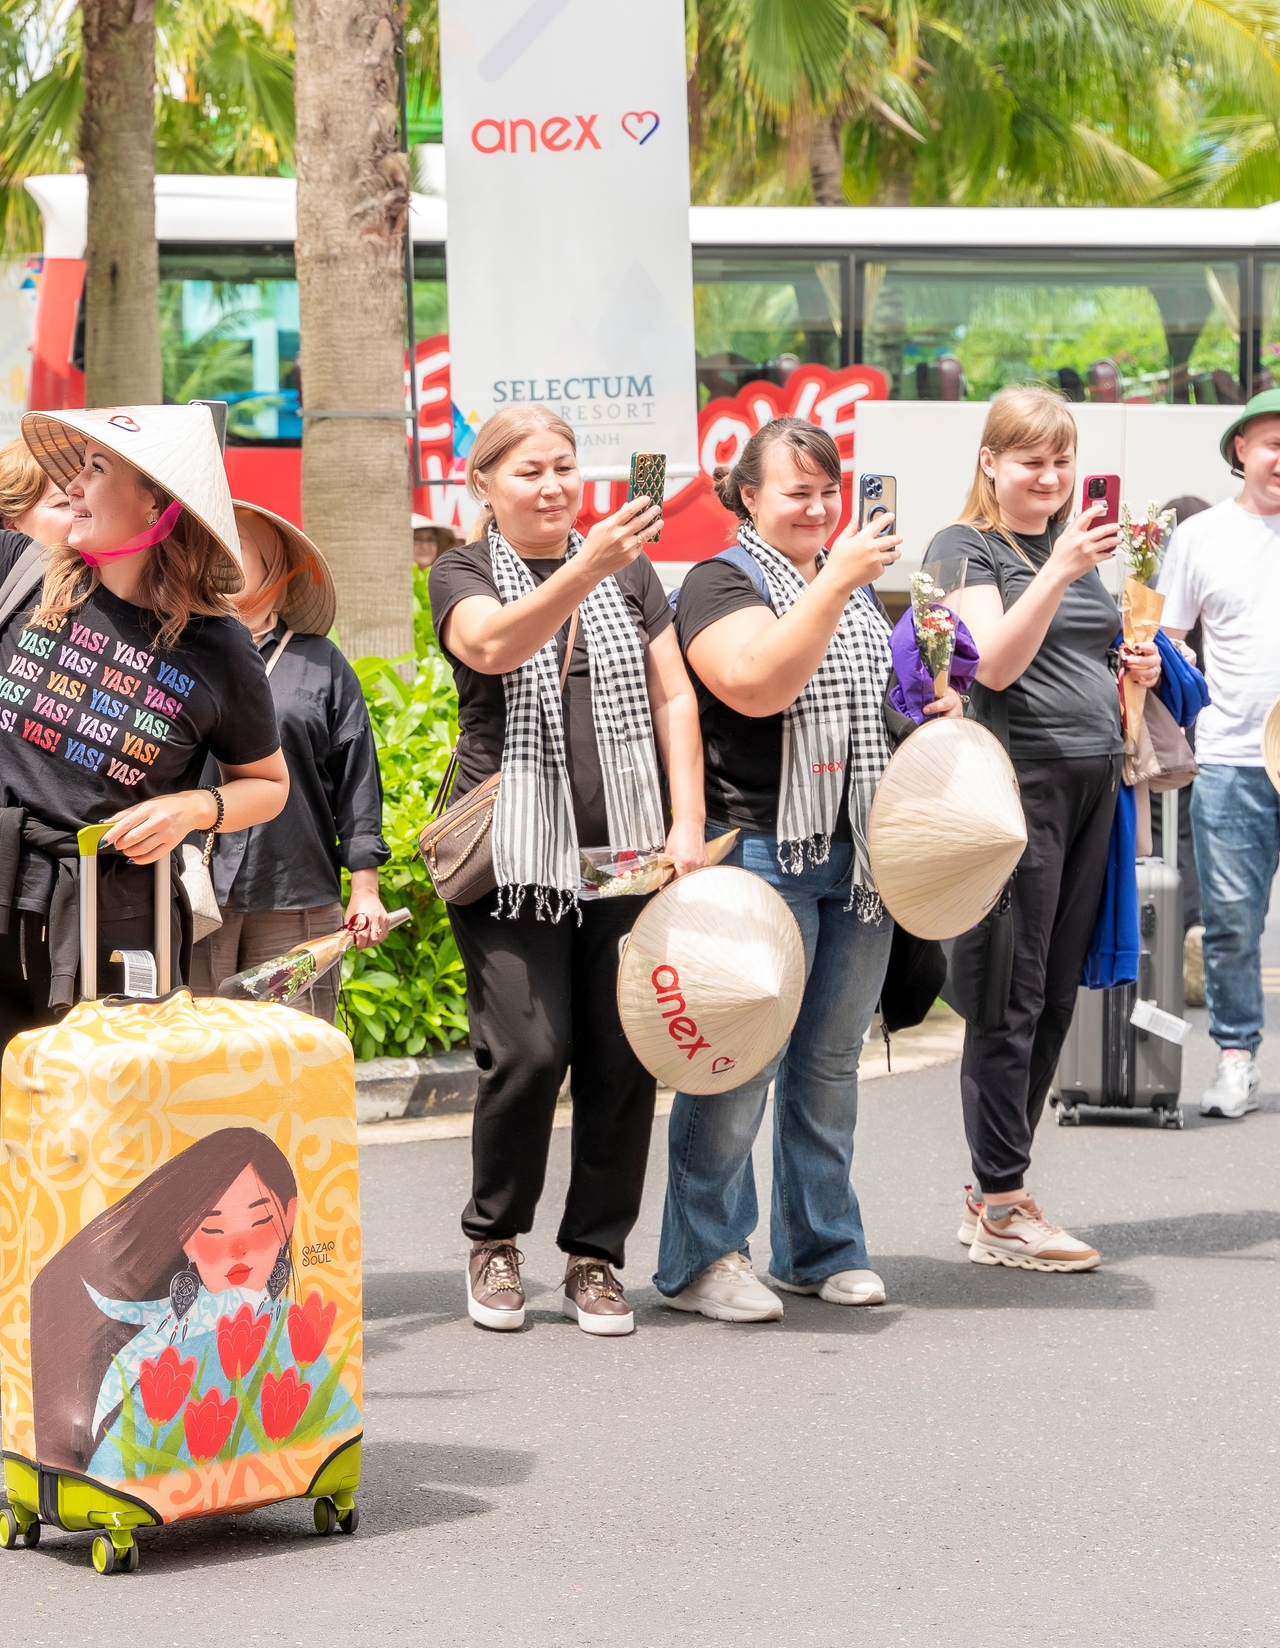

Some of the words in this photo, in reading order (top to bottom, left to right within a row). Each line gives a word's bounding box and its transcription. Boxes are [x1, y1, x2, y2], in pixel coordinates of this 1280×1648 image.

[471, 114, 603, 154] anex
[493, 375, 655, 403] SELECTUM
[561, 403, 655, 421] RESORT
[17, 630, 56, 660] YAS!
[58, 645, 98, 678] YAS!
[100, 666, 141, 698] YAS!
[142, 684, 183, 720] YAS!
[69, 622, 110, 654] YAS!
[112, 641, 155, 674] YAS!
[156, 661, 195, 697] YAS!
[6, 654, 44, 683] YAS!
[46, 670, 87, 703] YAS!
[89, 688, 129, 721] YAS!
[132, 708, 169, 741] YAS!
[32, 692, 74, 726] YAS!
[76, 713, 118, 746] YAS!
[121, 732, 161, 766] YAS!
[22, 718, 62, 753] YAS!
[64, 737, 105, 772] YAS!
[106, 757, 147, 786] YAS!
[812, 761, 844, 773] anex
[651, 964, 712, 1061] anex
[302, 1252, 332, 1267] SOUL
